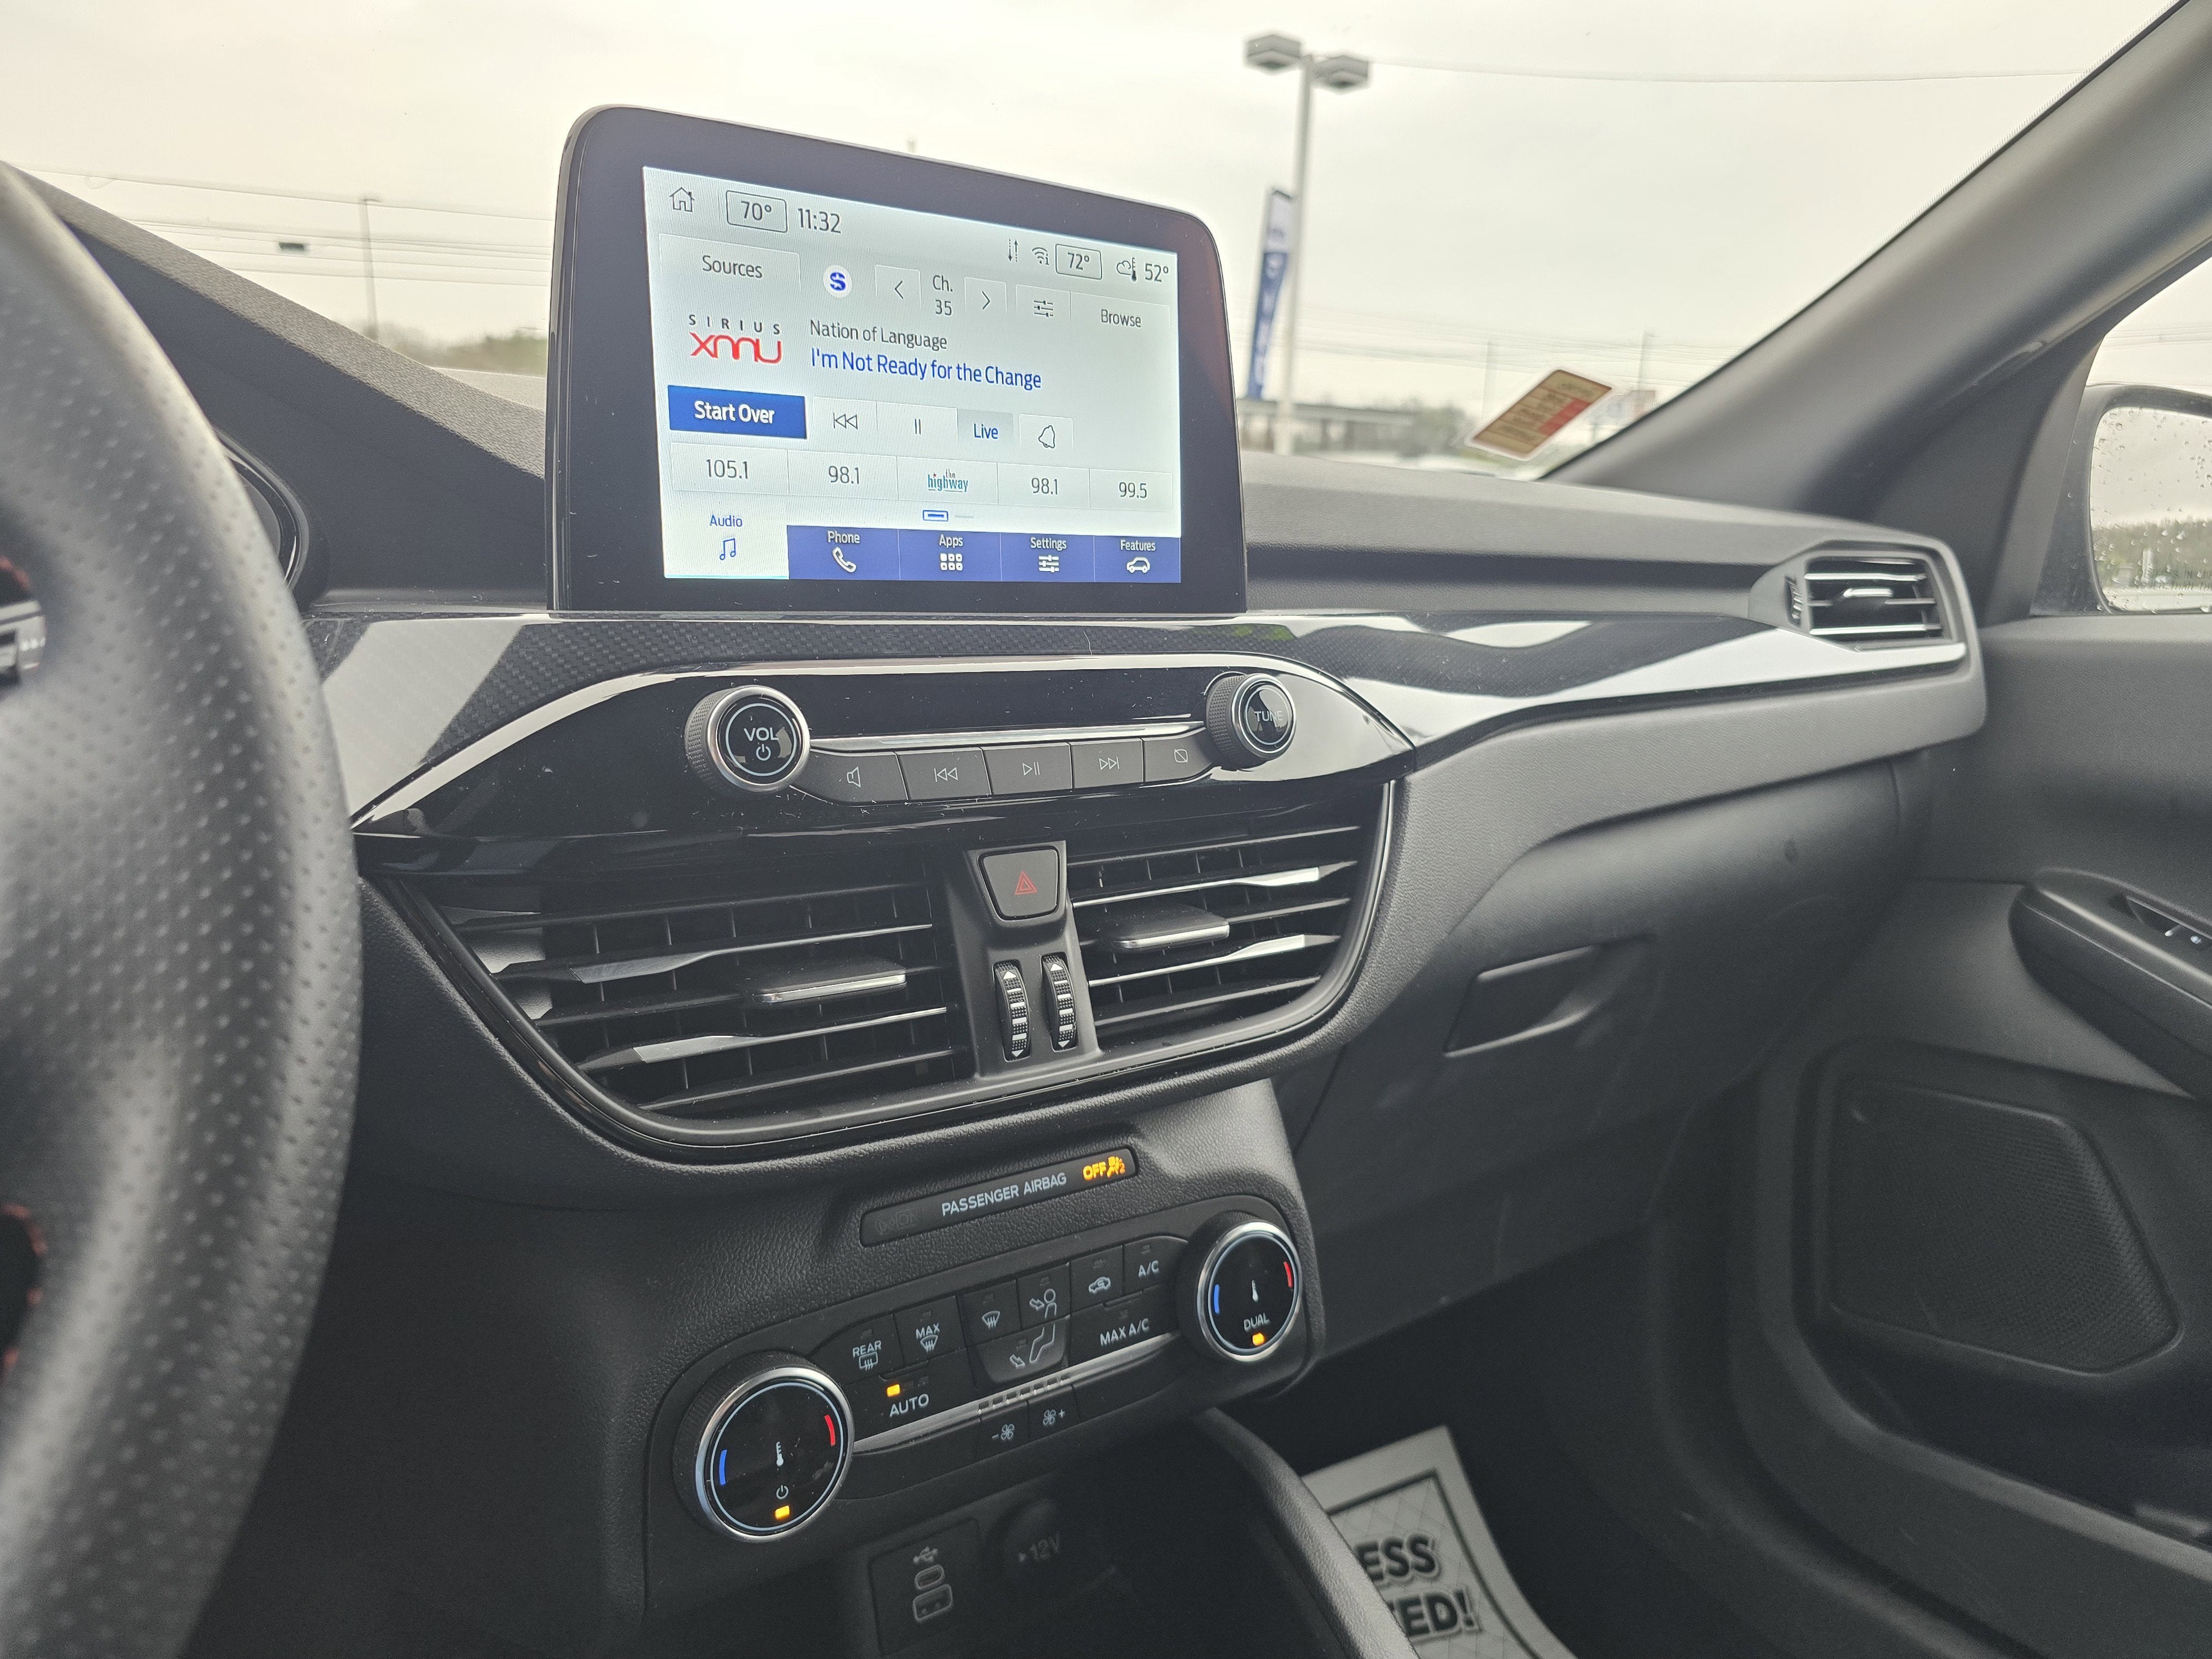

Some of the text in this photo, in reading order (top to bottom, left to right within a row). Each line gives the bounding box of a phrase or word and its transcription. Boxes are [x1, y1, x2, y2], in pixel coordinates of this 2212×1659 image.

[740, 201, 772, 221] 70°
[798, 208, 841, 233] 11:32
[702, 255, 763, 278] Sources
[1067, 252, 1089, 270] 72°
[1144, 264, 1169, 283] 52°
[932, 274, 953, 293] Ch.
[935, 299, 952, 316] 35
[689, 314, 780, 335] SIRIUS
[1100, 309, 1141, 328] Browse
[810, 319, 947, 351] Nation of Language
[811, 348, 1042, 391] I'm Not Ready for the Change
[694, 400, 775, 424] Start Over
[974, 424, 998, 440] Live
[706, 459, 749, 479] 105.1
[829, 466, 859, 484] 98.1
[945, 468, 956, 478] the
[927, 474, 968, 492] highway
[1031, 477, 1058, 495] 98.1
[1119, 482, 1147, 499] 99.5
[709, 514, 743, 528] Audio
[827, 531, 860, 544] Phone
[939, 534, 963, 547] Apps
[1030, 537, 1067, 551] Settings
[1120, 539, 1156, 552] Features
[1254, 711, 1283, 722] TUNE
[744, 727, 780, 742] VOL
[942, 1162, 1107, 1217] PASSENGER AIRBAG OFF
[1138, 1260, 1159, 1278] A/C
[915, 1323, 940, 1339] MAX
[1244, 1313, 1270, 1332] DUAL
[1099, 1318, 1150, 1347] MAX A/C
[852, 1340, 882, 1358] REAR
[889, 1394, 929, 1417] AUTO
[1389, 1589, 1474, 1637] ED!
